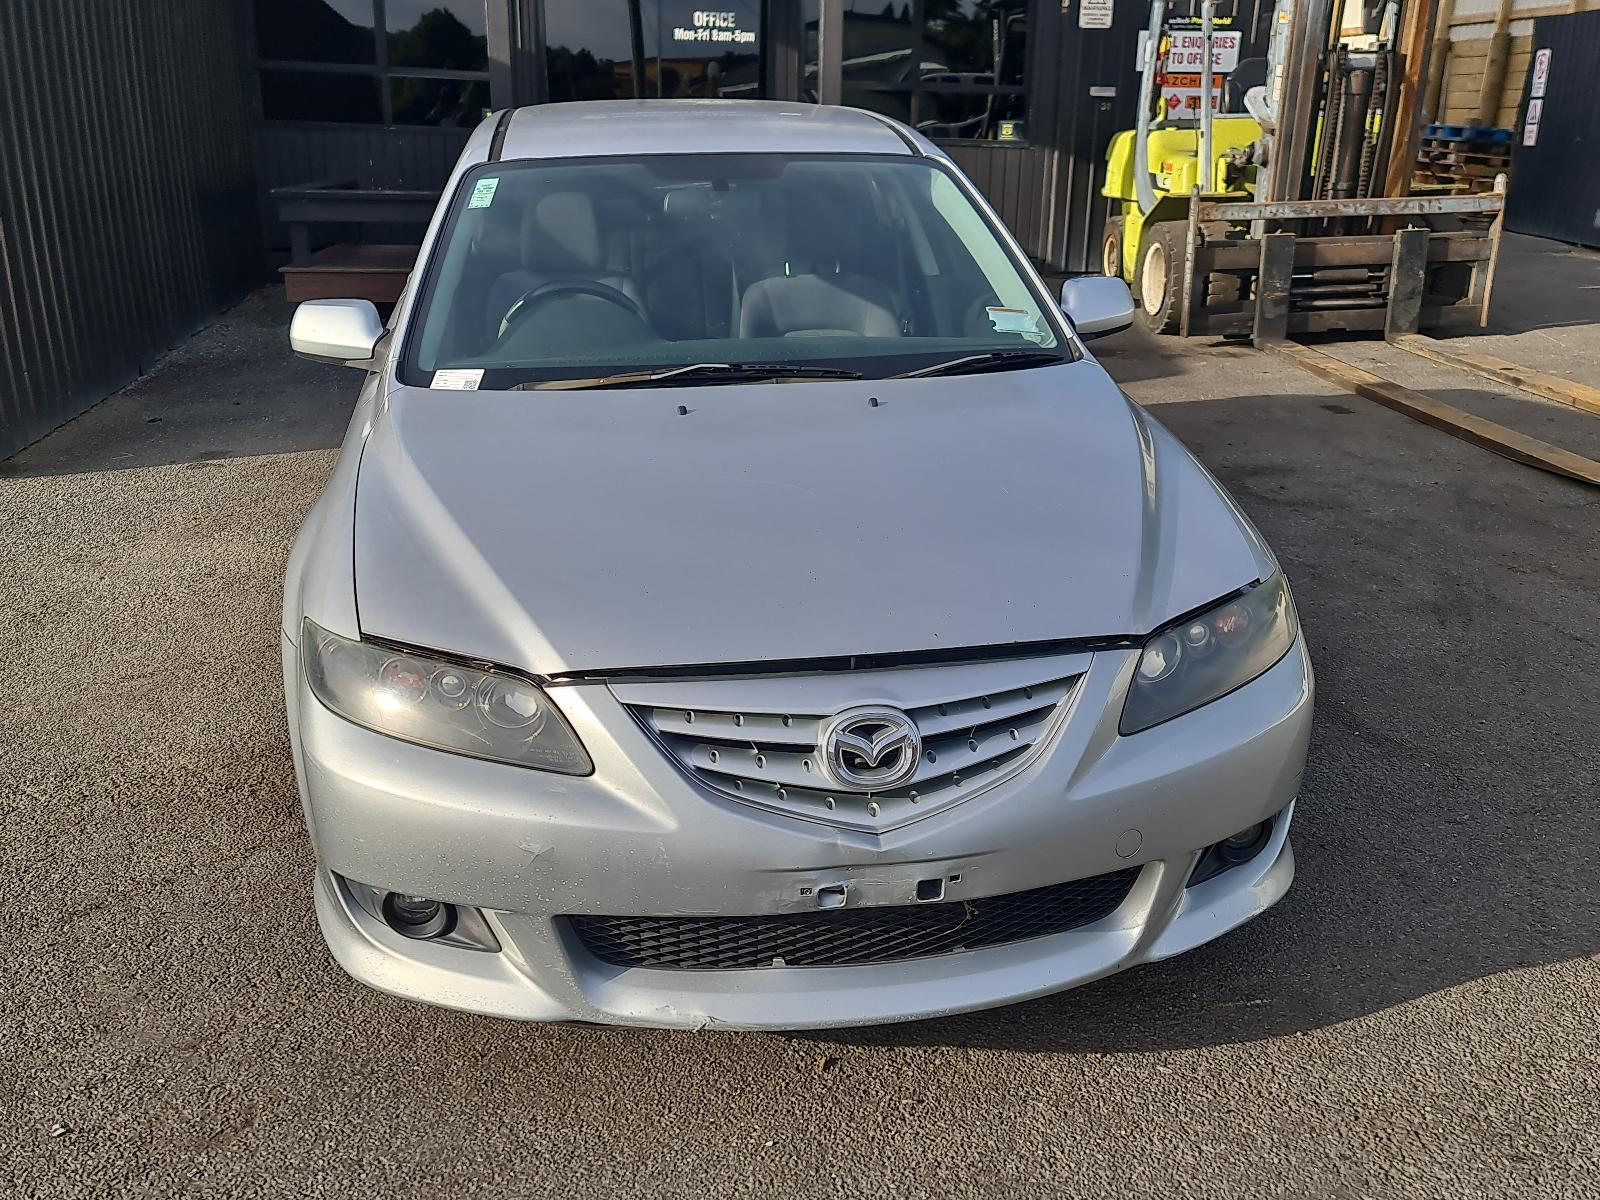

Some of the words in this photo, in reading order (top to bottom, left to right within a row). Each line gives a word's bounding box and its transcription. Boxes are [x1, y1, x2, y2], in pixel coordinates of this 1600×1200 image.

[692, 10, 736, 27] OFFICE
[673, 28, 710, 41] Mon-Fri
[711, 29, 756, 43] 8am-5pm
[1182, 36, 1237, 49] ENQRIES
[1172, 52, 1184, 65] TO
[1187, 52, 1223, 65] OFE
